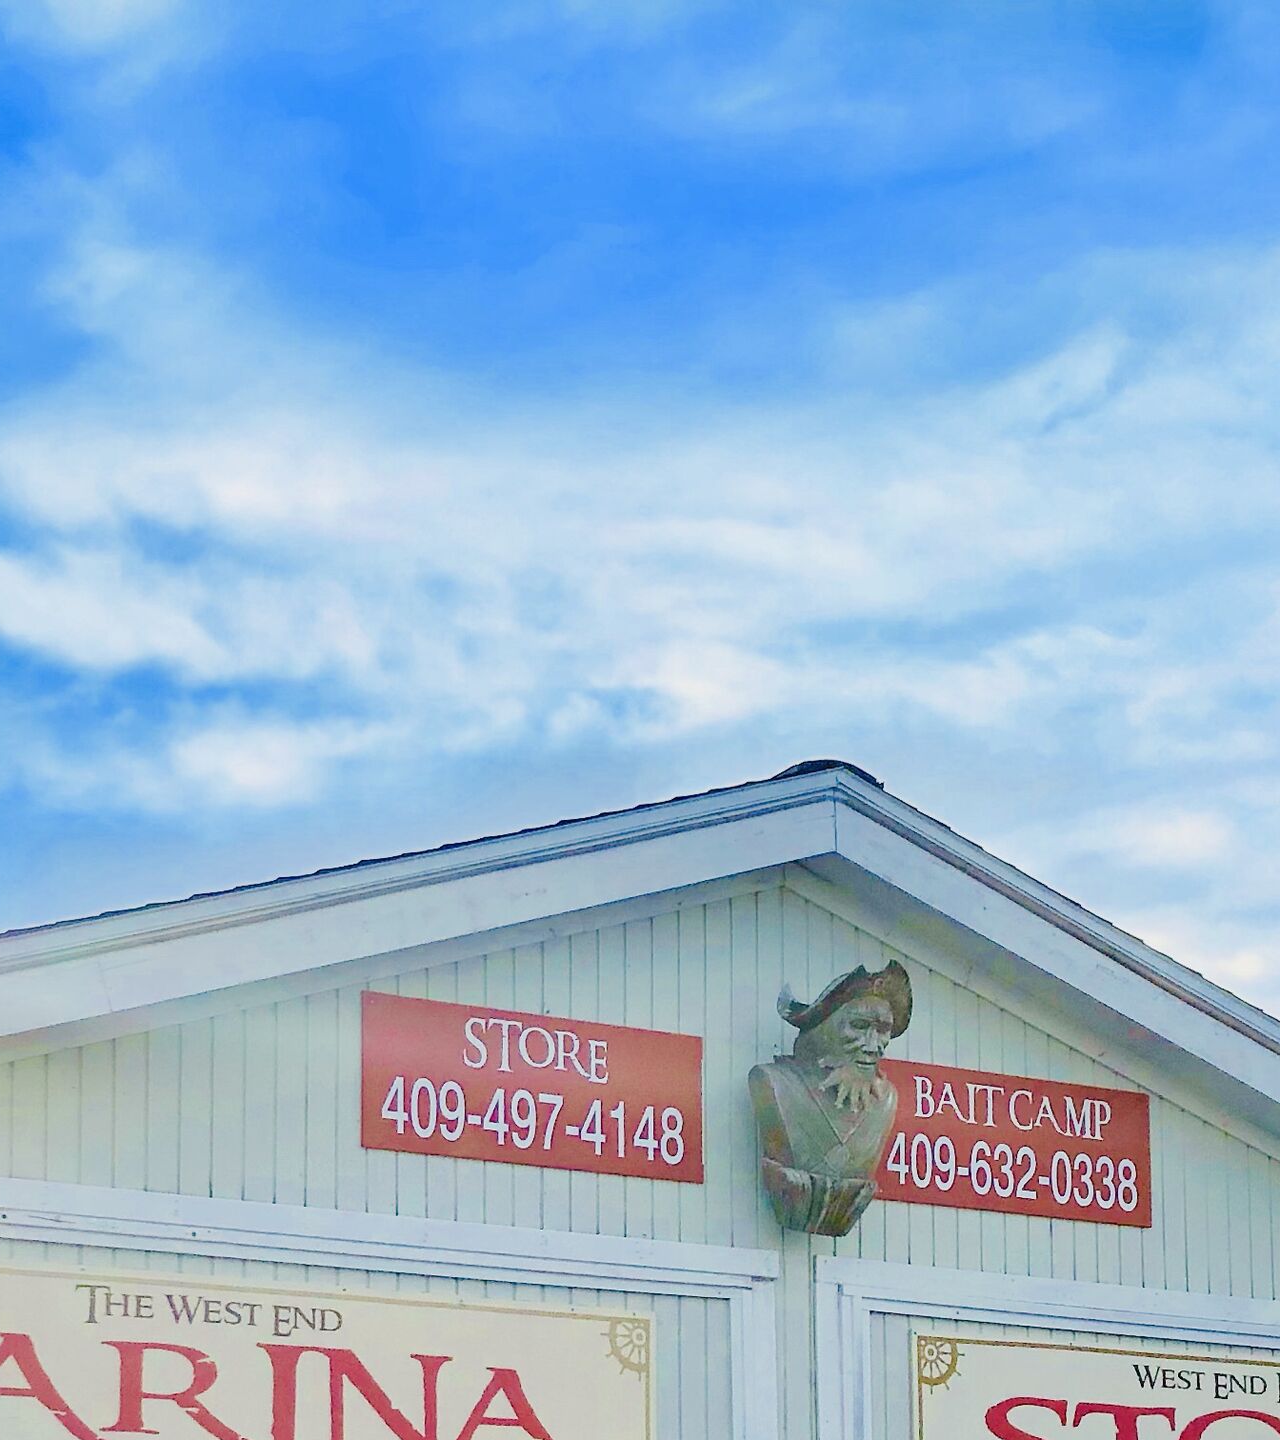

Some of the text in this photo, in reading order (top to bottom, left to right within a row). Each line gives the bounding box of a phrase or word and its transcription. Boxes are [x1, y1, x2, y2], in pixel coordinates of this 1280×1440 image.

[463, 1018, 609, 1084] STORE
[380, 1076, 685, 1166] 409-497-4148
[914, 1076, 1112, 1143] BAIT CAMP
[887, 1132, 1138, 1212] 409-632-0338
[165, 1294, 259, 1329] WEST
[273, 1304, 344, 1338] END
[1133, 1365, 1206, 1393] WEST
[1214, 1373, 1268, 1400] END
